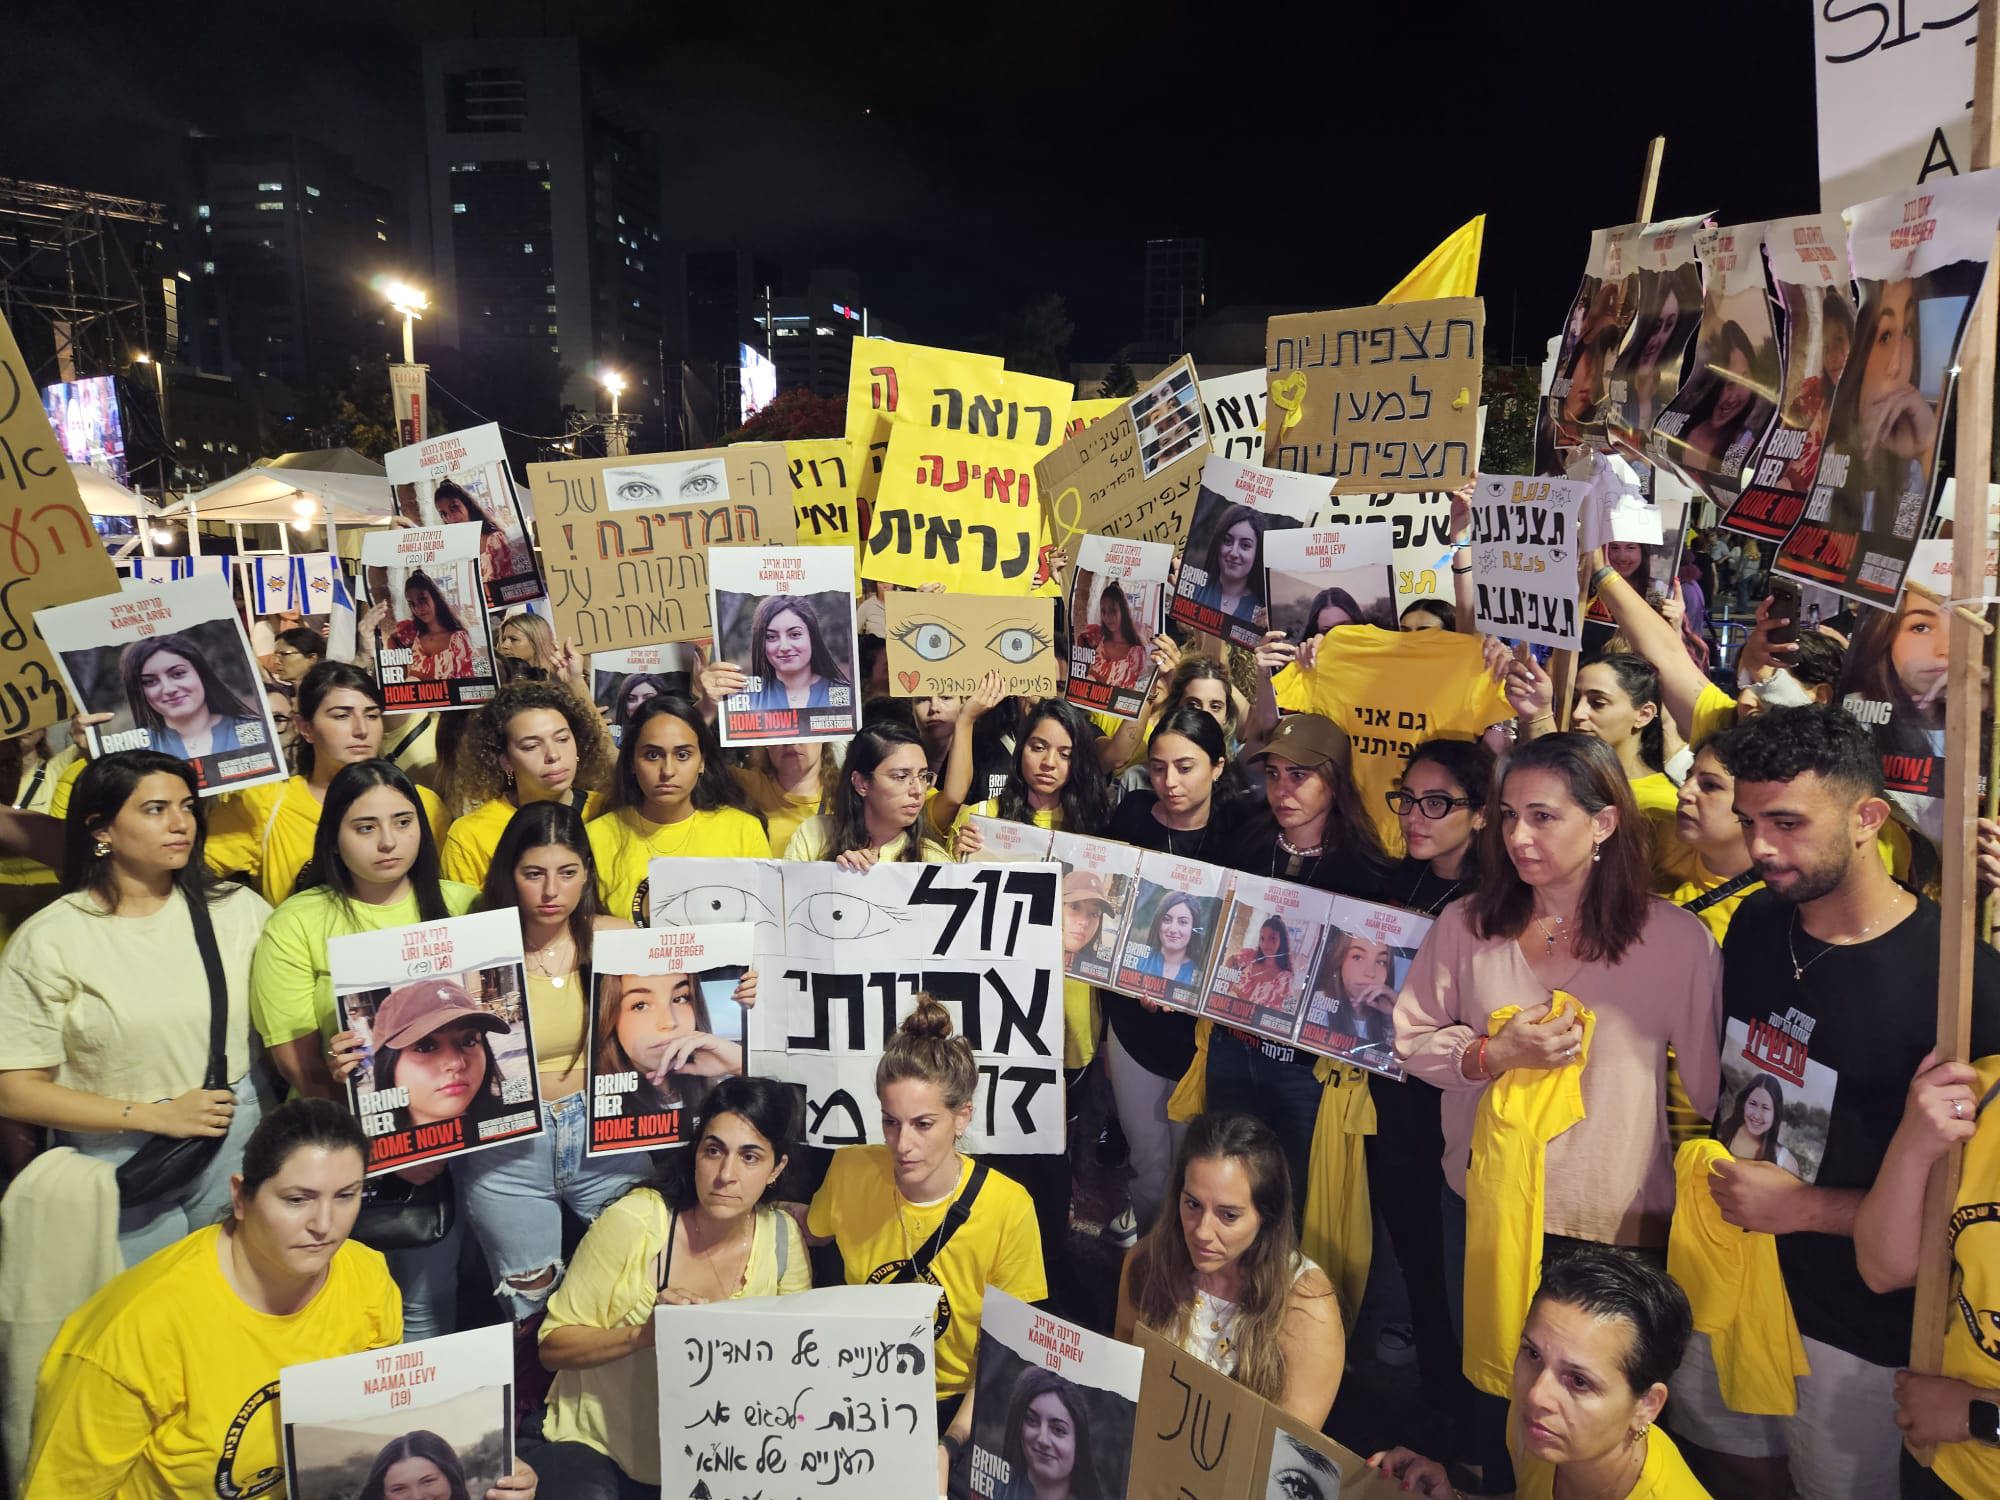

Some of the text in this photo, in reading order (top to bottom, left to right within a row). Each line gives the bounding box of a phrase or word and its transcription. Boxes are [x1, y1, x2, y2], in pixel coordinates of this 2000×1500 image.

[1270, 319, 1474, 373] תצפיתניות
[931, 388, 1052, 446] רואה
[1333, 374, 1432, 436] למען
[1766, 429, 1807, 459] BRING
[419, 447, 468, 468] DANIELA GILBOA
[1109, 446, 1133, 468] של
[916, 454, 1031, 508] ואינה
[1756, 458, 1785, 487] HER
[1820, 452, 1850, 488] BRING
[547, 470, 598, 517] של
[1235, 479, 1274, 499] KARINA ARIEV
[1735, 489, 1770, 520] HOME
[1805, 487, 1832, 522] HER
[397, 540, 445, 554] DANIELA GILBOA
[868, 508, 1031, 580] נראית
[1305, 543, 1346, 556] NAAMA LEVY
[1785, 525, 1825, 559] HOME
[1825, 530, 1859, 569] NOW!
[550, 565, 594, 608] על
[759, 570, 806, 581] KARINA ARIEV
[1181, 563, 1208, 587] BRING
[1177, 579, 1195, 600] HER
[110, 607, 173, 631] KARINA ARIEV
[574, 598, 686, 648] האחיות
[1173, 598, 1225, 629] HOME NOW!
[380, 647, 414, 666] BRING
[1071, 645, 1096, 665] BRING
[381, 666, 405, 684] HER
[1071, 662, 1087, 679] HER
[384, 685, 416, 704] HOME
[418, 680, 450, 701] NOW!
[727, 694, 751, 712] HER
[1068, 680, 1114, 704] HOME NOW!
[728, 713, 761, 731] HOME
[763, 708, 799, 731] NOW!
[1354, 707, 1427, 731] גם אני
[101, 728, 150, 754] BRING
[907, 864, 1057, 957] קול
[401, 940, 454, 961] LIRI ALBAG
[648, 944, 705, 960] AGAM BERGER
[1122, 953, 1139, 969] HER
[1126, 941, 1151, 959] BRING
[1119, 969, 1167, 993] HOME NOW!
[1218, 964, 1242, 984] BRING
[1212, 978, 1229, 995] HER
[1208, 996, 1256, 1019] HOME NOW!
[1311, 993, 1340, 1014] BRING
[1307, 1008, 1329, 1026] HER
[1303, 1023, 1327, 1041] HOME
[594, 1071, 639, 1096] BRING
[359, 1085, 410, 1115] BRING
[594, 1095, 623, 1118] HER
[361, 1110, 396, 1137] HER
[415, 1119, 464, 1146] NOW!
[594, 1109, 680, 1142] HOME NOW!
[1027, 1327, 1085, 1364] KARINA ARIEV
[1056, 1326, 1081, 1346] קרינה
[376, 1350, 423, 1374] נעמה לוי
[684, 1329, 820, 1388] של המדינה
[1045, 1353, 1062, 1372] (19)
[363, 1366, 436, 1396] NAAMA LEVY
[814, 1396, 918, 1435] רוצות
[1157, 1360, 1231, 1471] של
[756, 1434, 787, 1474] של
[972, 1443, 1011, 1485] BRING
[970, 1469, 995, 1498] HER
